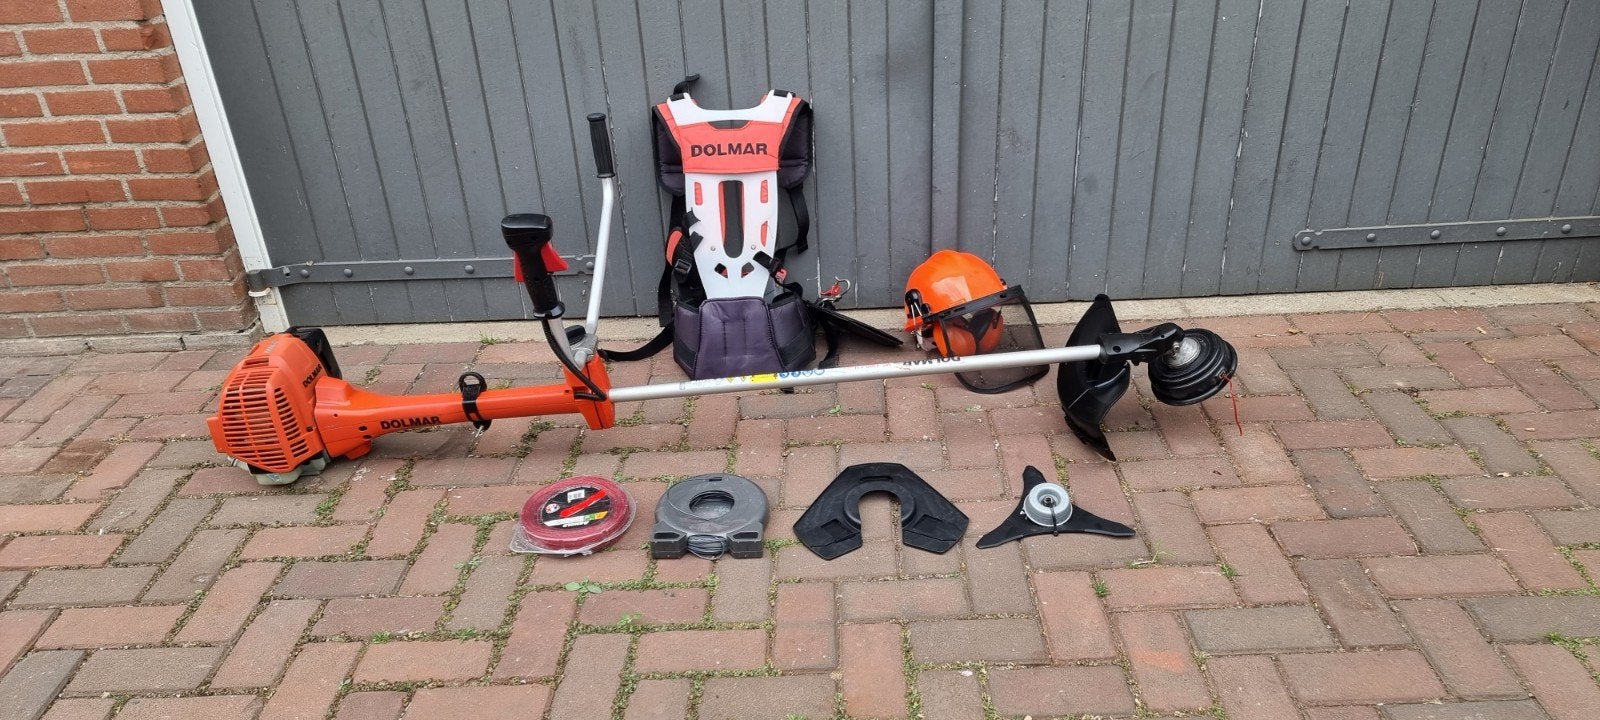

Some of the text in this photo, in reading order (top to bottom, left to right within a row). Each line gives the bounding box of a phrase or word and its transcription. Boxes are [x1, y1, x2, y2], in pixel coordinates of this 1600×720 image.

[690, 142, 768, 157] DOLMAR
[302, 363, 323, 388] DOLMAR
[380, 416, 441, 429] DOLMAR
